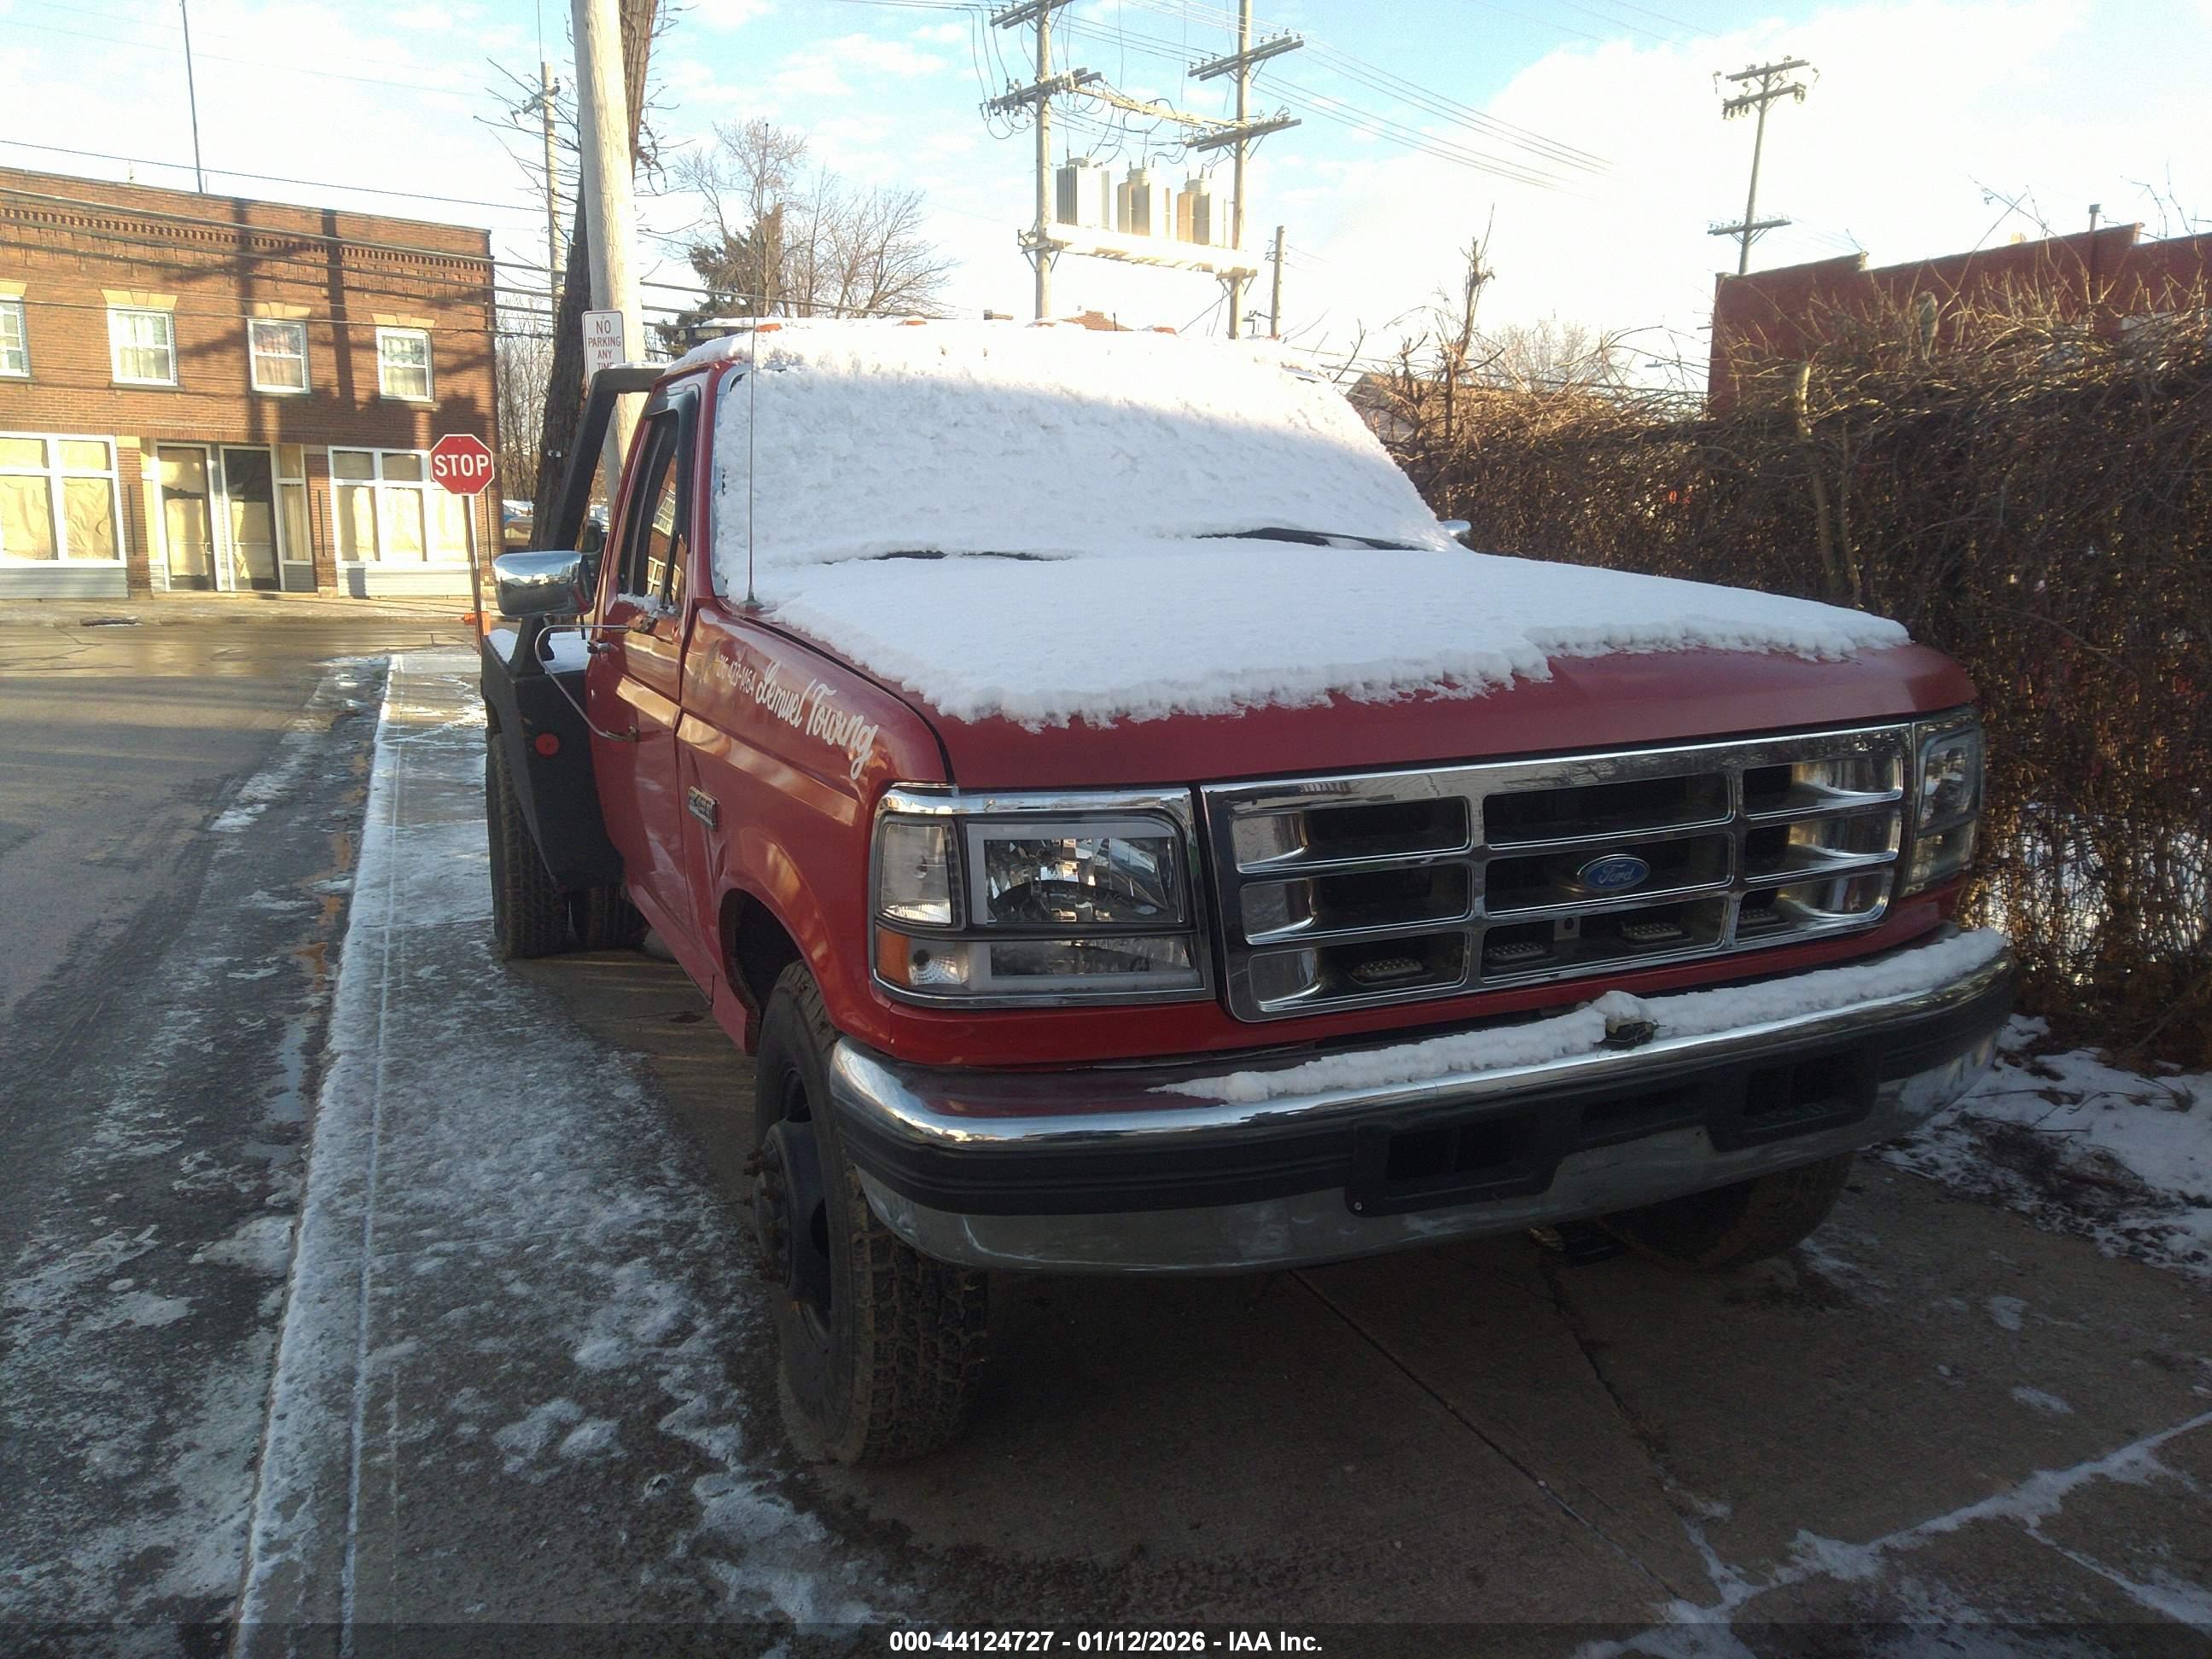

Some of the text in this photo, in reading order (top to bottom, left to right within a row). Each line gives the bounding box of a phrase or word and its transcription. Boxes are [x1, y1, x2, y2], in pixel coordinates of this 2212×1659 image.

[596, 320, 611, 335] NO
[588, 336, 621, 348] PARKING
[597, 349, 613, 359] ANY
[434, 454, 489, 477] STOP
[755, 660, 817, 728] Lemuel
[806, 683, 879, 780] Towing
[1598, 863, 1635, 884] Ford
